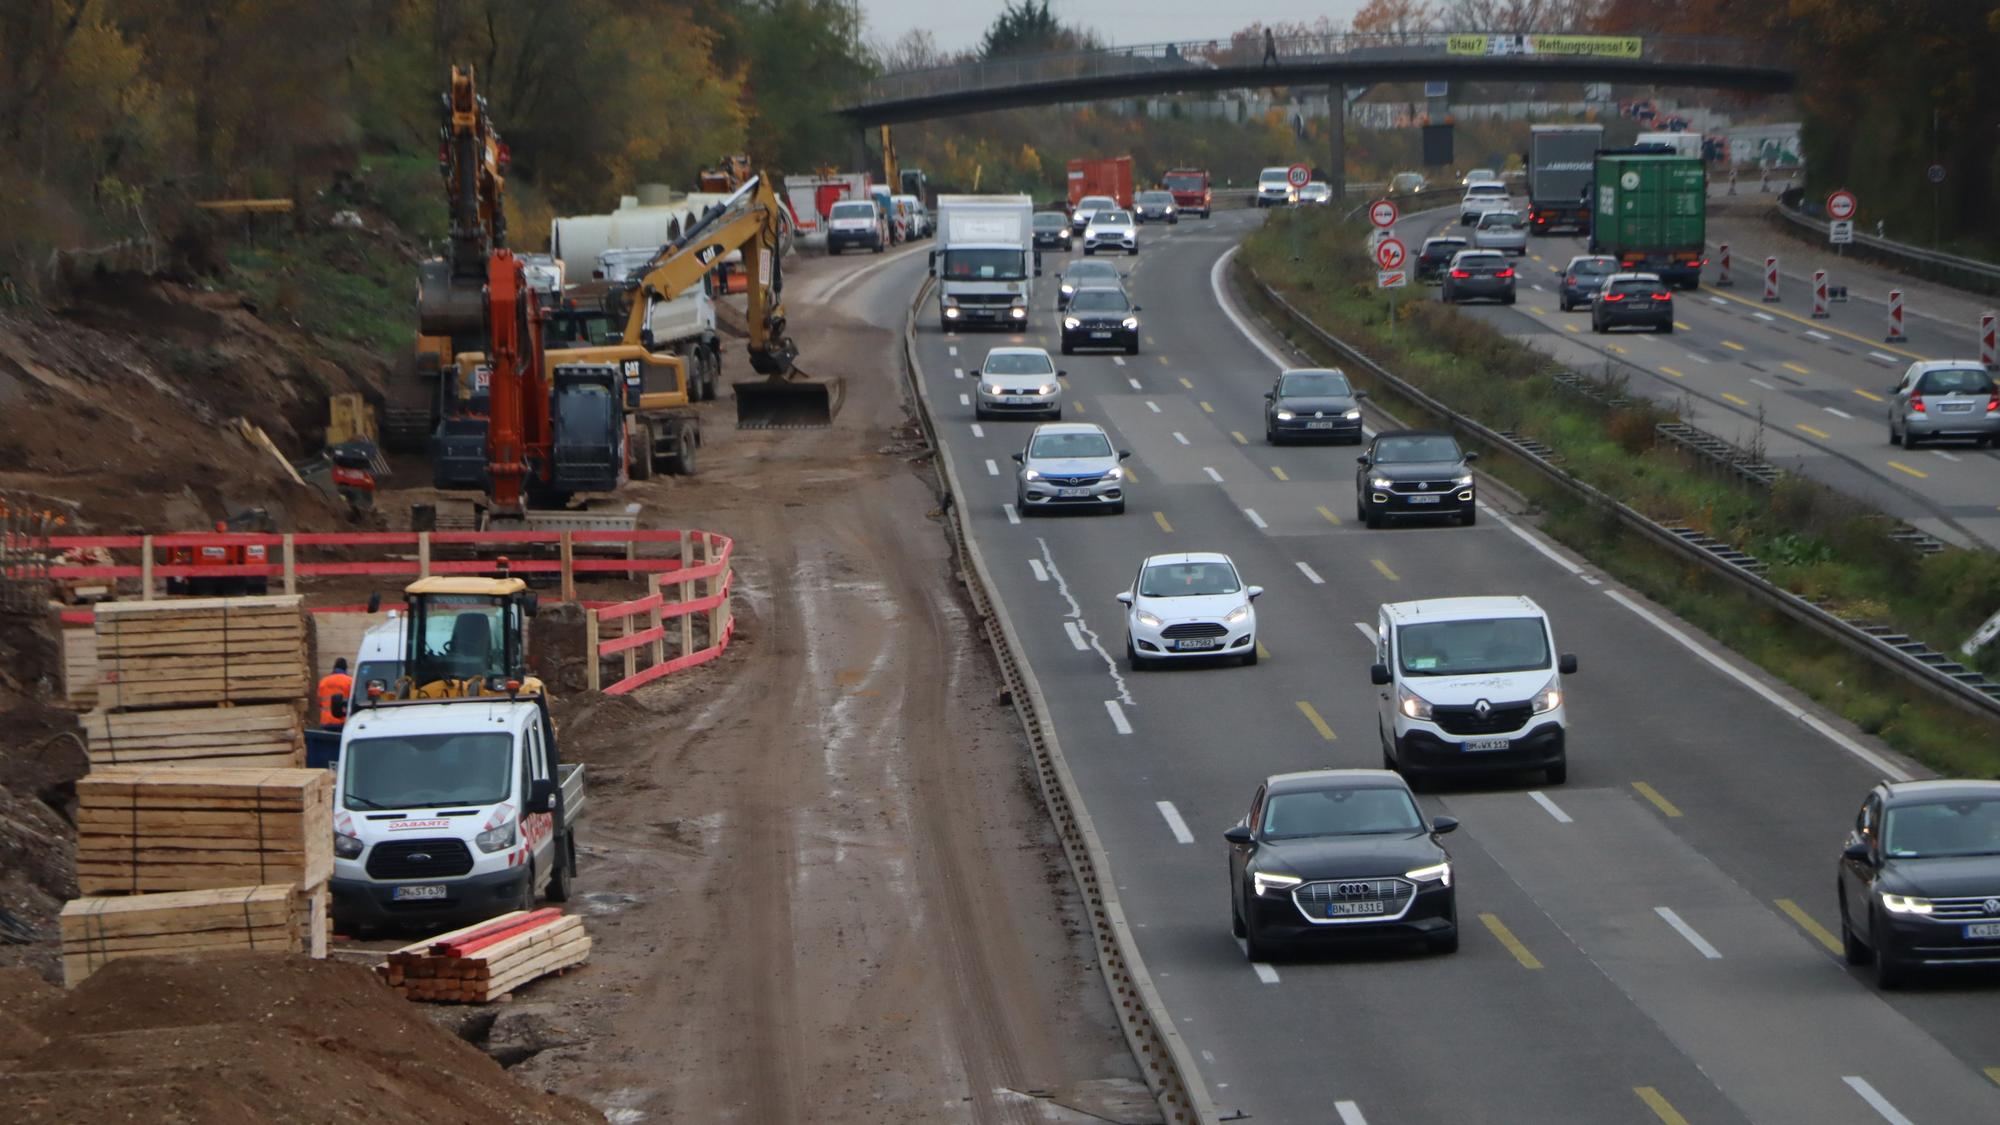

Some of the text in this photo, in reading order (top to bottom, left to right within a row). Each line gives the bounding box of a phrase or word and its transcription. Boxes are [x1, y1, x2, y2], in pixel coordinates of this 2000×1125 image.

[1450, 37, 1483, 51] Stau?
[1291, 171, 1306, 182] 80
[702, 245, 716, 264] CAT
[624, 360, 640, 377] CAT
[1332, 904, 1345, 914] BN
